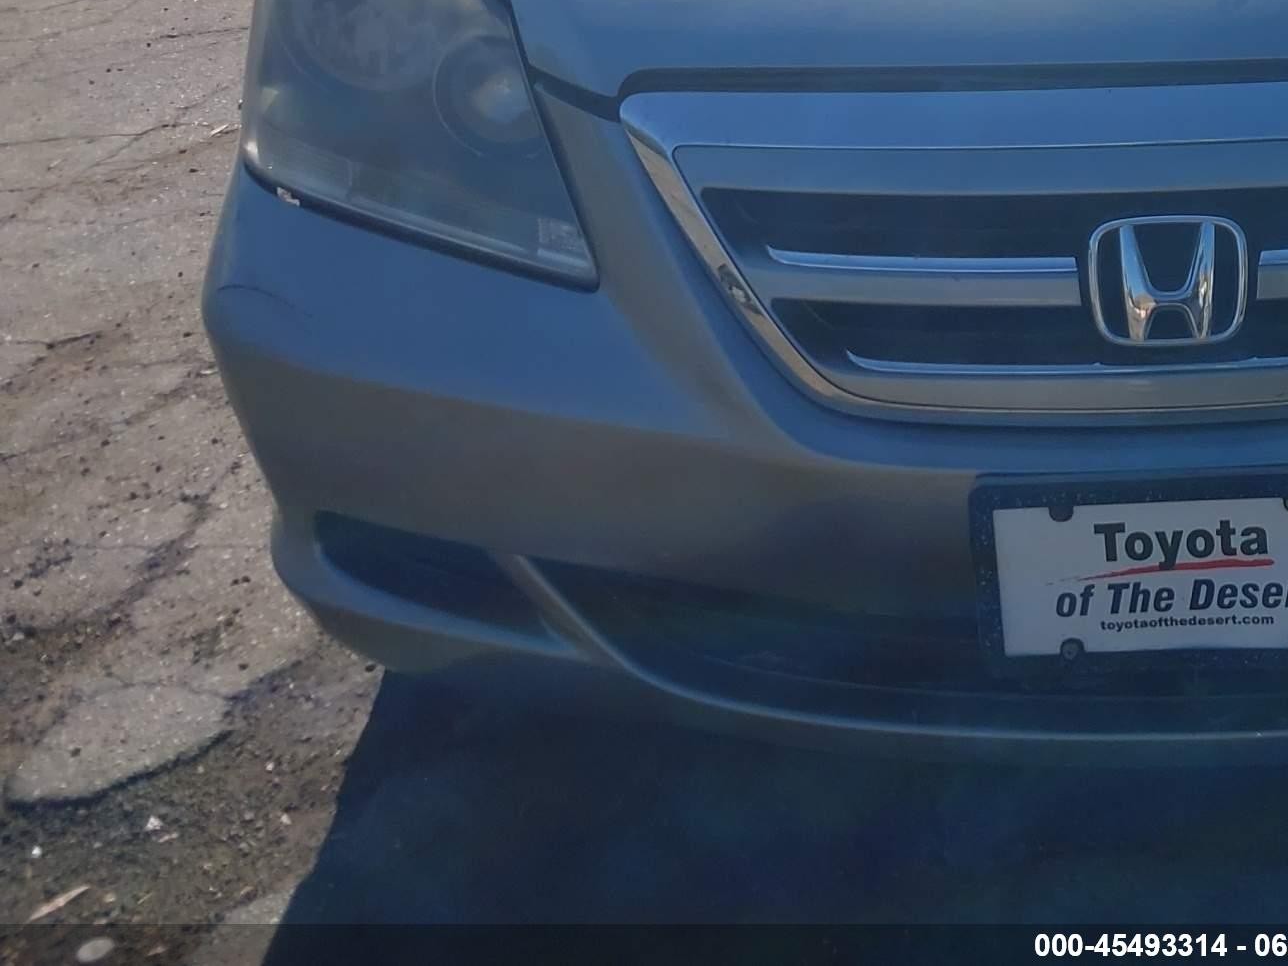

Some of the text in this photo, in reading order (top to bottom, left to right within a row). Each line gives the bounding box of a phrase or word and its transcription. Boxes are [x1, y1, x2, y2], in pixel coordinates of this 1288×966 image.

[1094, 519, 1269, 570] Toyota
[1056, 584, 1095, 617] of
[1108, 581, 1175, 615] The
[1100, 613, 1275, 632] toyotaofthedesert.com
